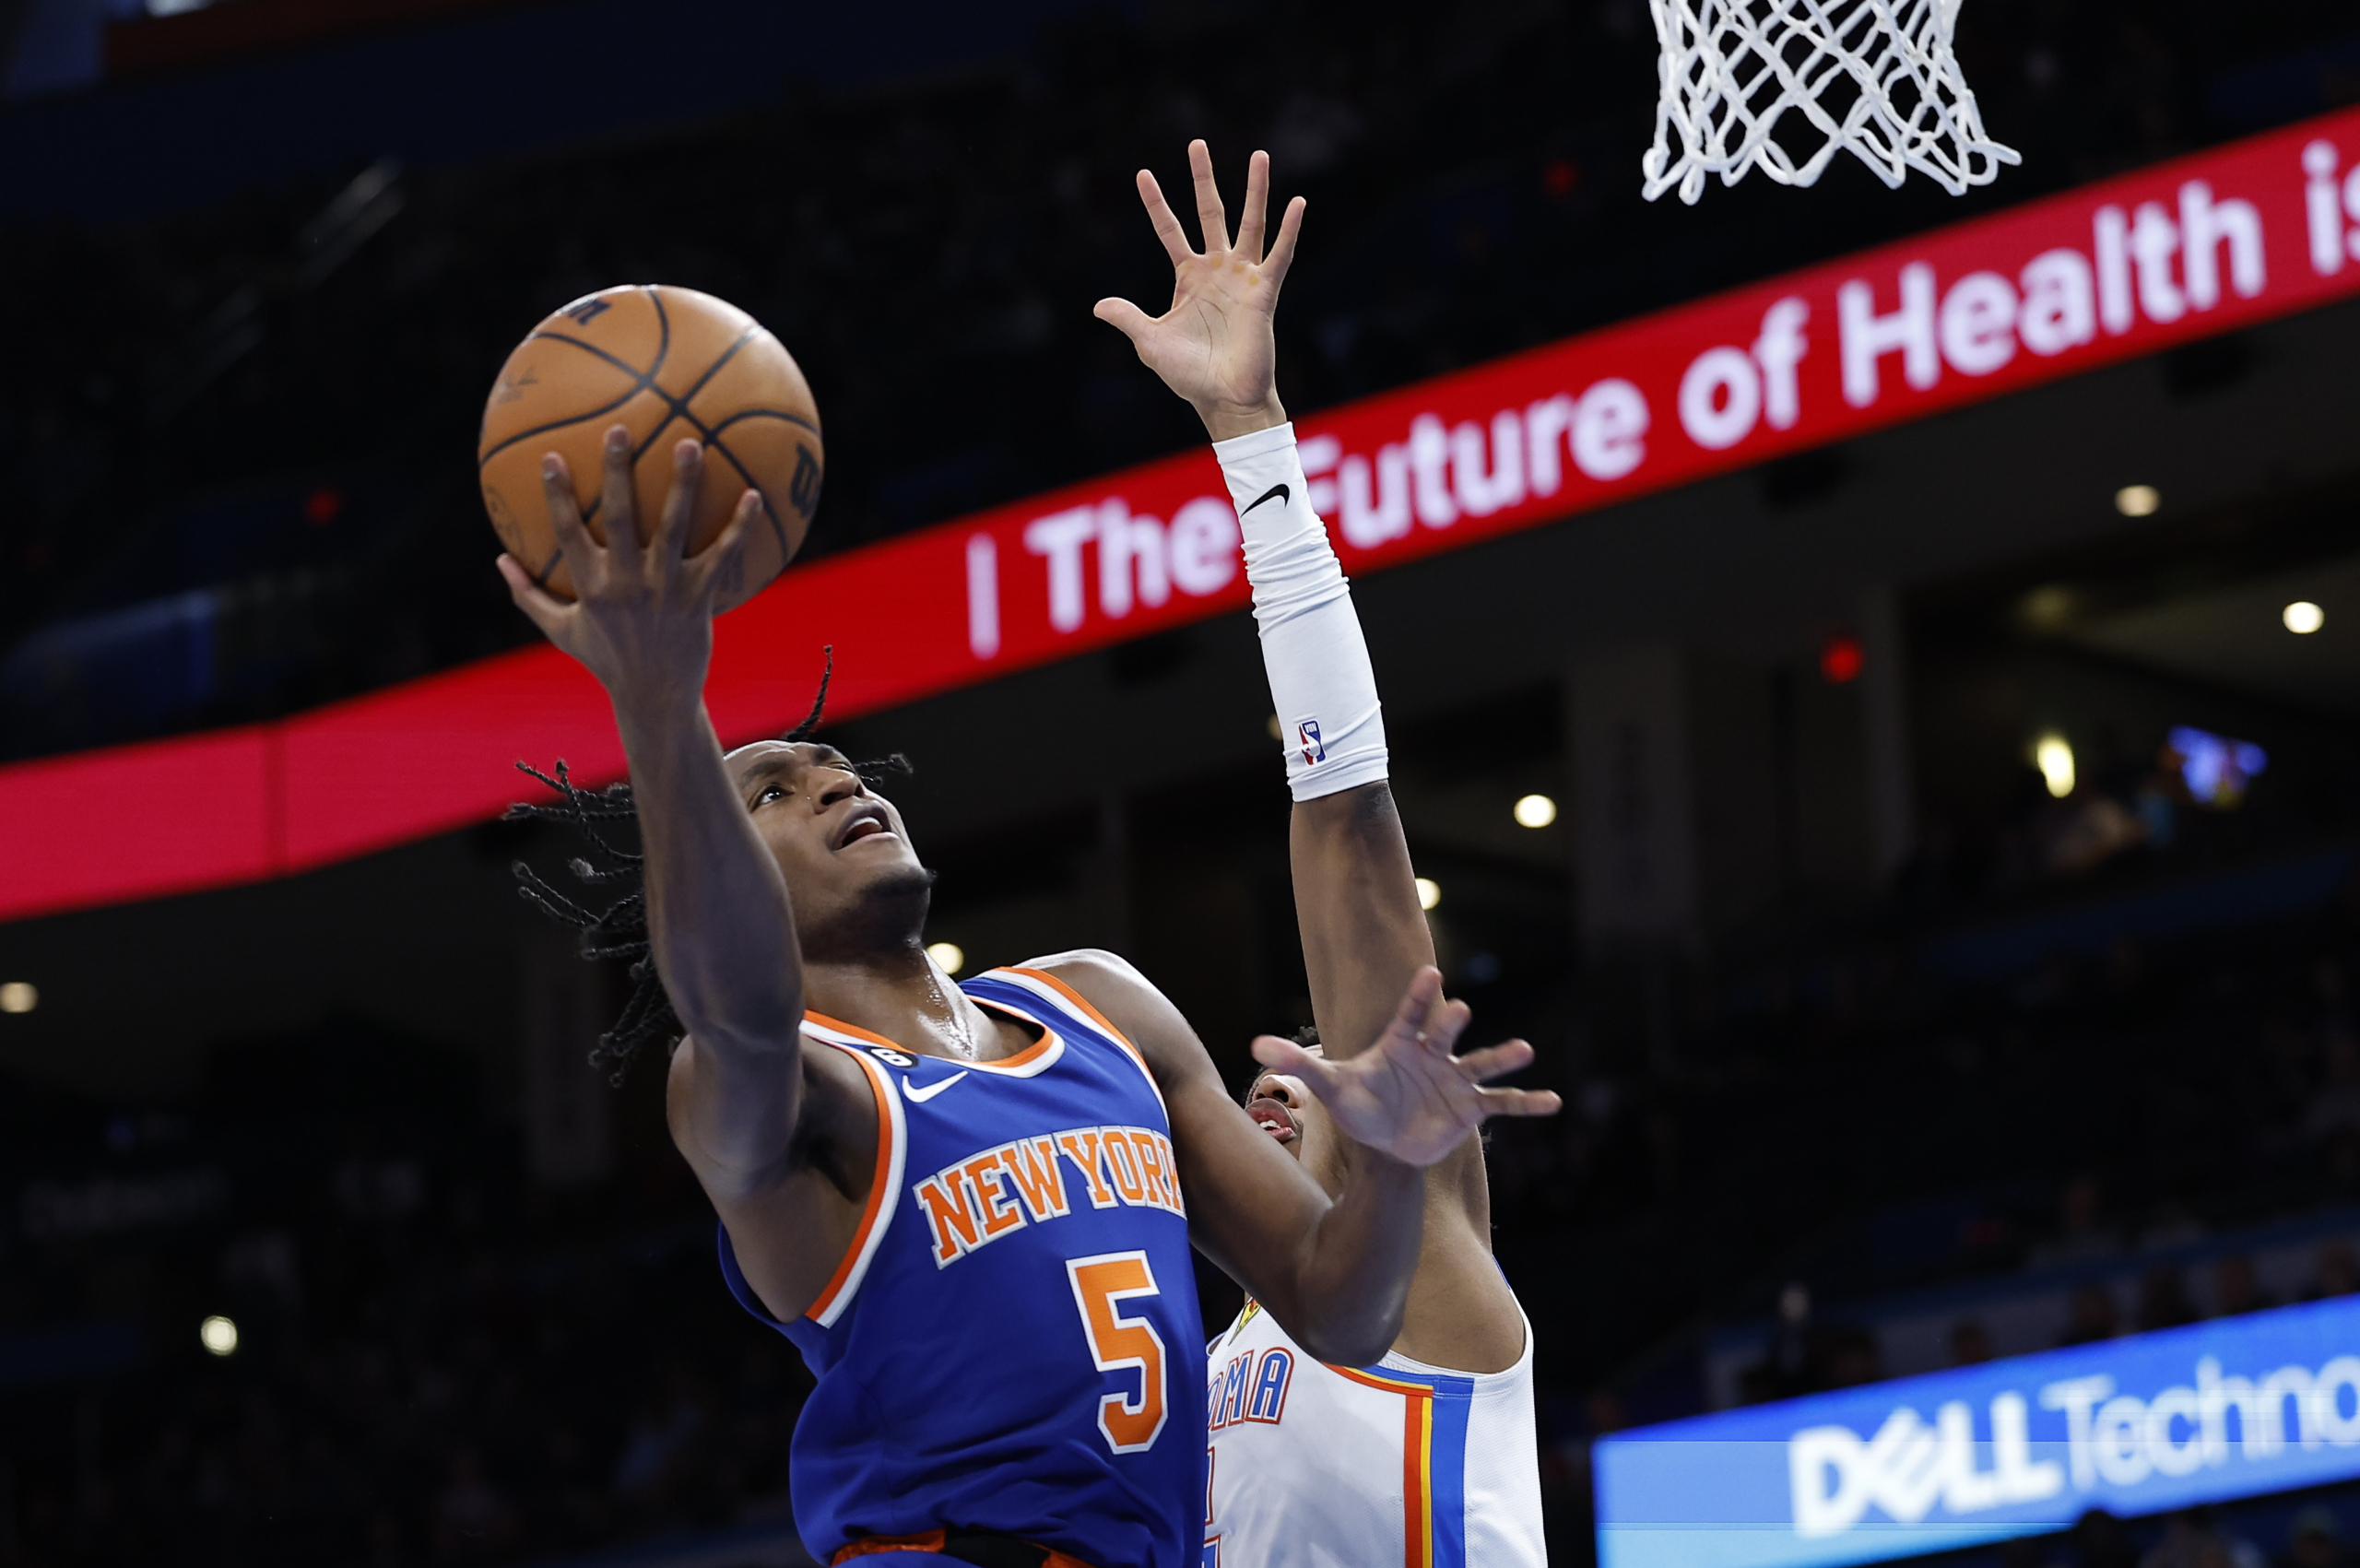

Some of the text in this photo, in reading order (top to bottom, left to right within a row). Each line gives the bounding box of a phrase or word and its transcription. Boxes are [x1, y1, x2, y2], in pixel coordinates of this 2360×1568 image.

[1025, 495, 1240, 633] The
[1678, 296, 1811, 450] of
[1836, 179, 2267, 408] Health
[2301, 138, 2360, 277] i
[870, 1048, 913, 1067] 6
[913, 1133, 1071, 1270] NEW
[1065, 1250, 1169, 1455] 5
[1788, 1390, 2063, 1539] DELL
